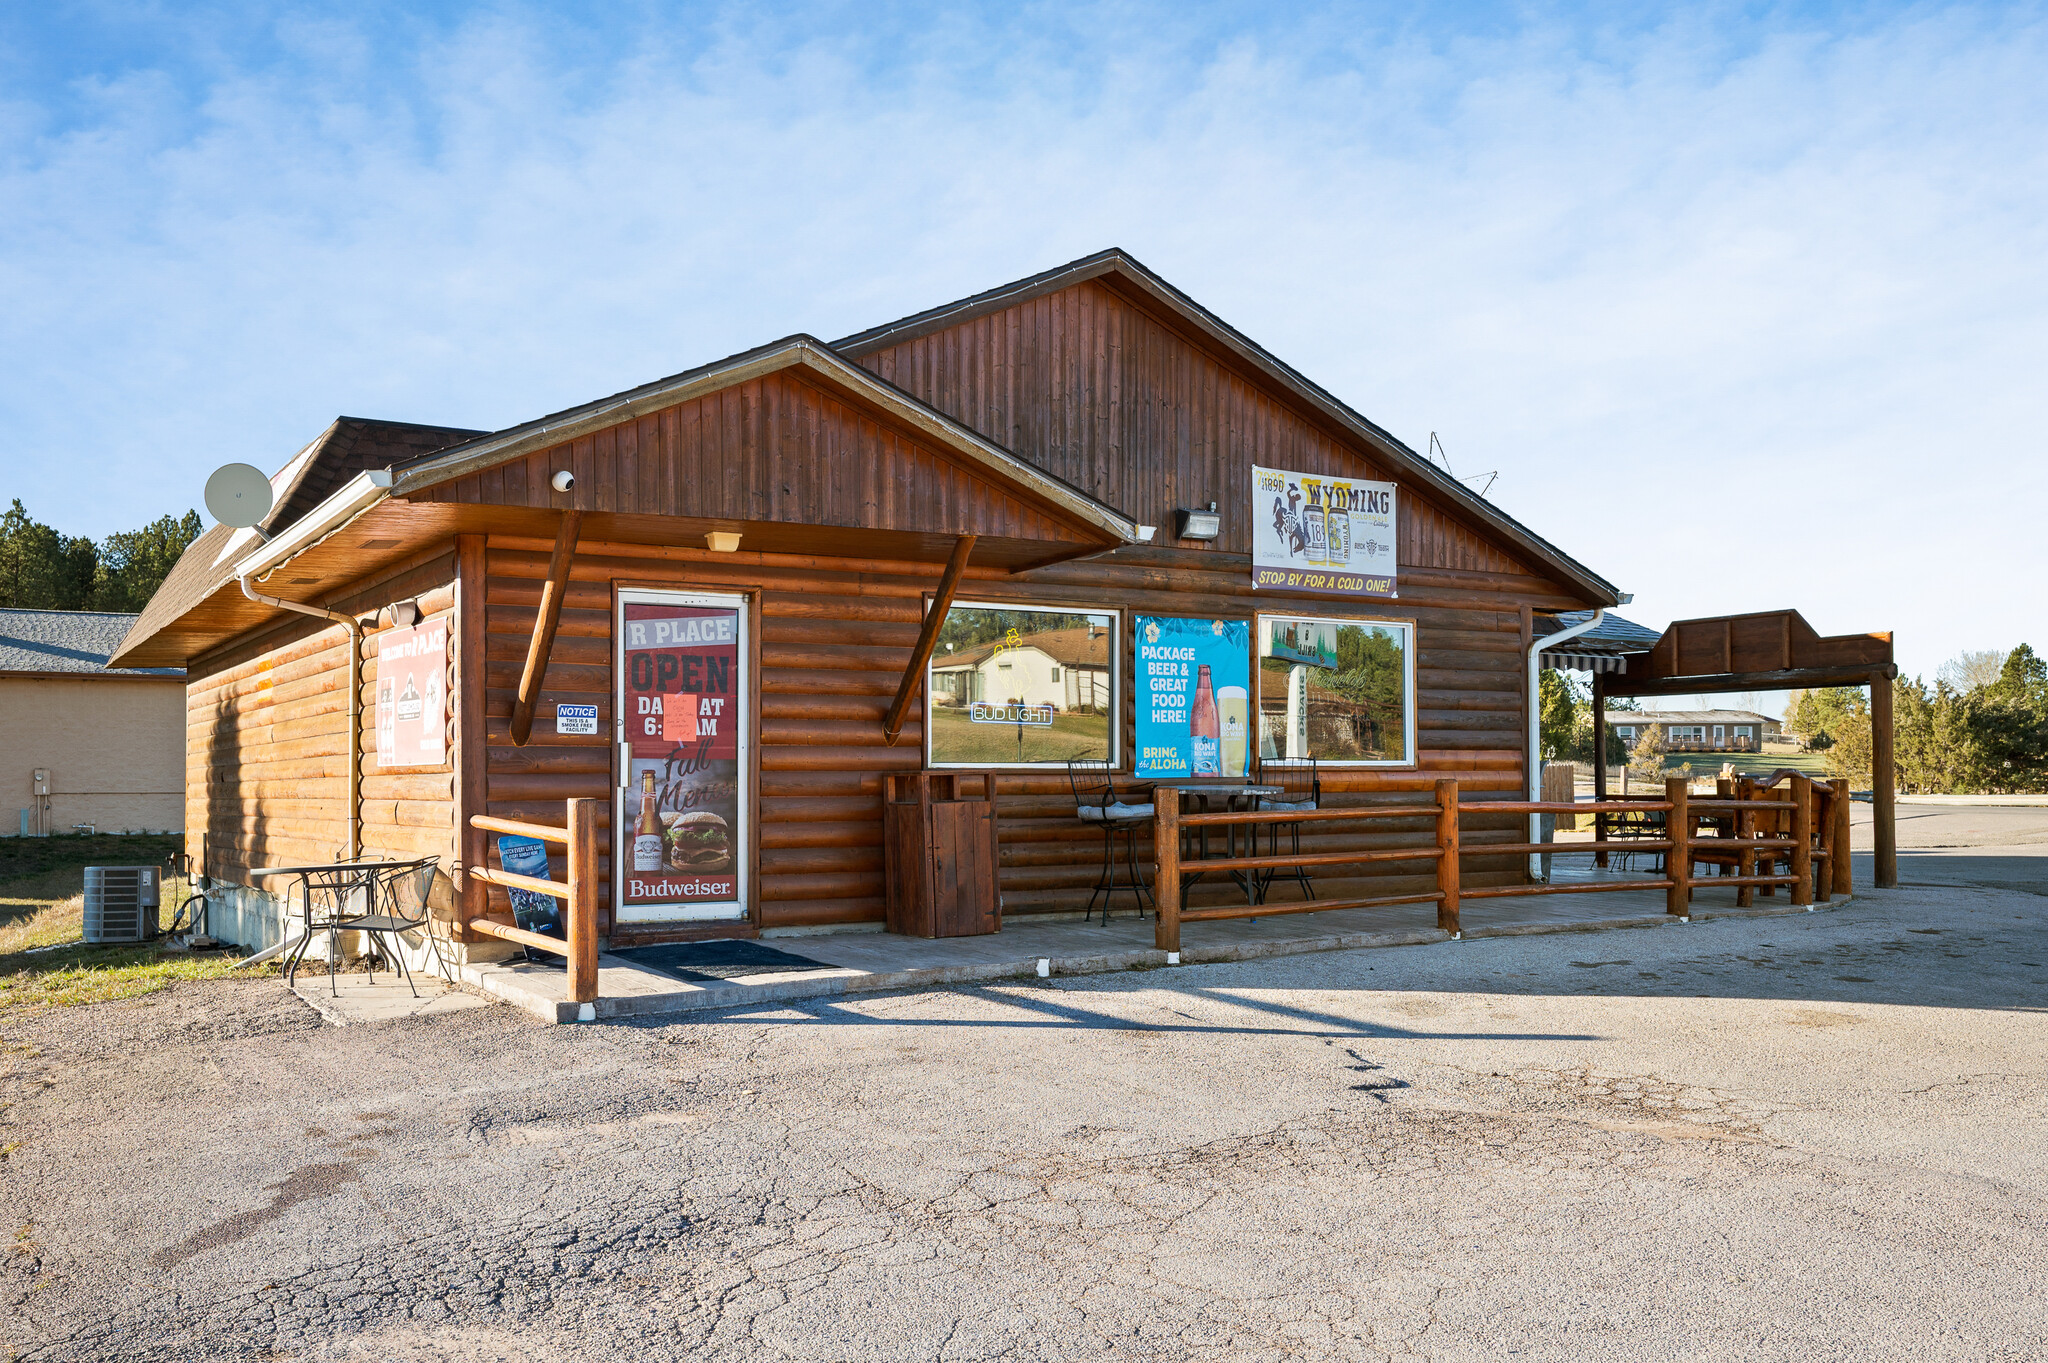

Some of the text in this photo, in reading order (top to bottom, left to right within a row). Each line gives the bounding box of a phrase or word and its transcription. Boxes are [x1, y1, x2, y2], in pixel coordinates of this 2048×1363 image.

[1265, 478, 1283, 492] 1890
[1307, 484, 1389, 514] WYOMING
[1350, 513, 1376, 521] GOLDEN
[1259, 571, 1391, 592] STOP BY FOR A COLD ONE!
[630, 619, 731, 645] R PLACE
[418, 628, 445, 656] PLACE
[1141, 646, 1196, 661] PACKAGE
[631, 652, 730, 693] OPEN
[1147, 662, 1190, 676] BEER &
[1150, 678, 1188, 691] GREAT
[699, 698, 725, 716] AT
[1152, 693, 1186, 707] FOOD
[559, 707, 595, 717] NOTICE
[973, 707, 1049, 722] BUD LIGHT
[1151, 709, 1187, 723] HERE!
[1143, 747, 1178, 758] BRING
[1194, 742, 1216, 751] KONA
[664, 737, 714, 781] Full
[1138, 759, 1187, 769] the ALOHA
